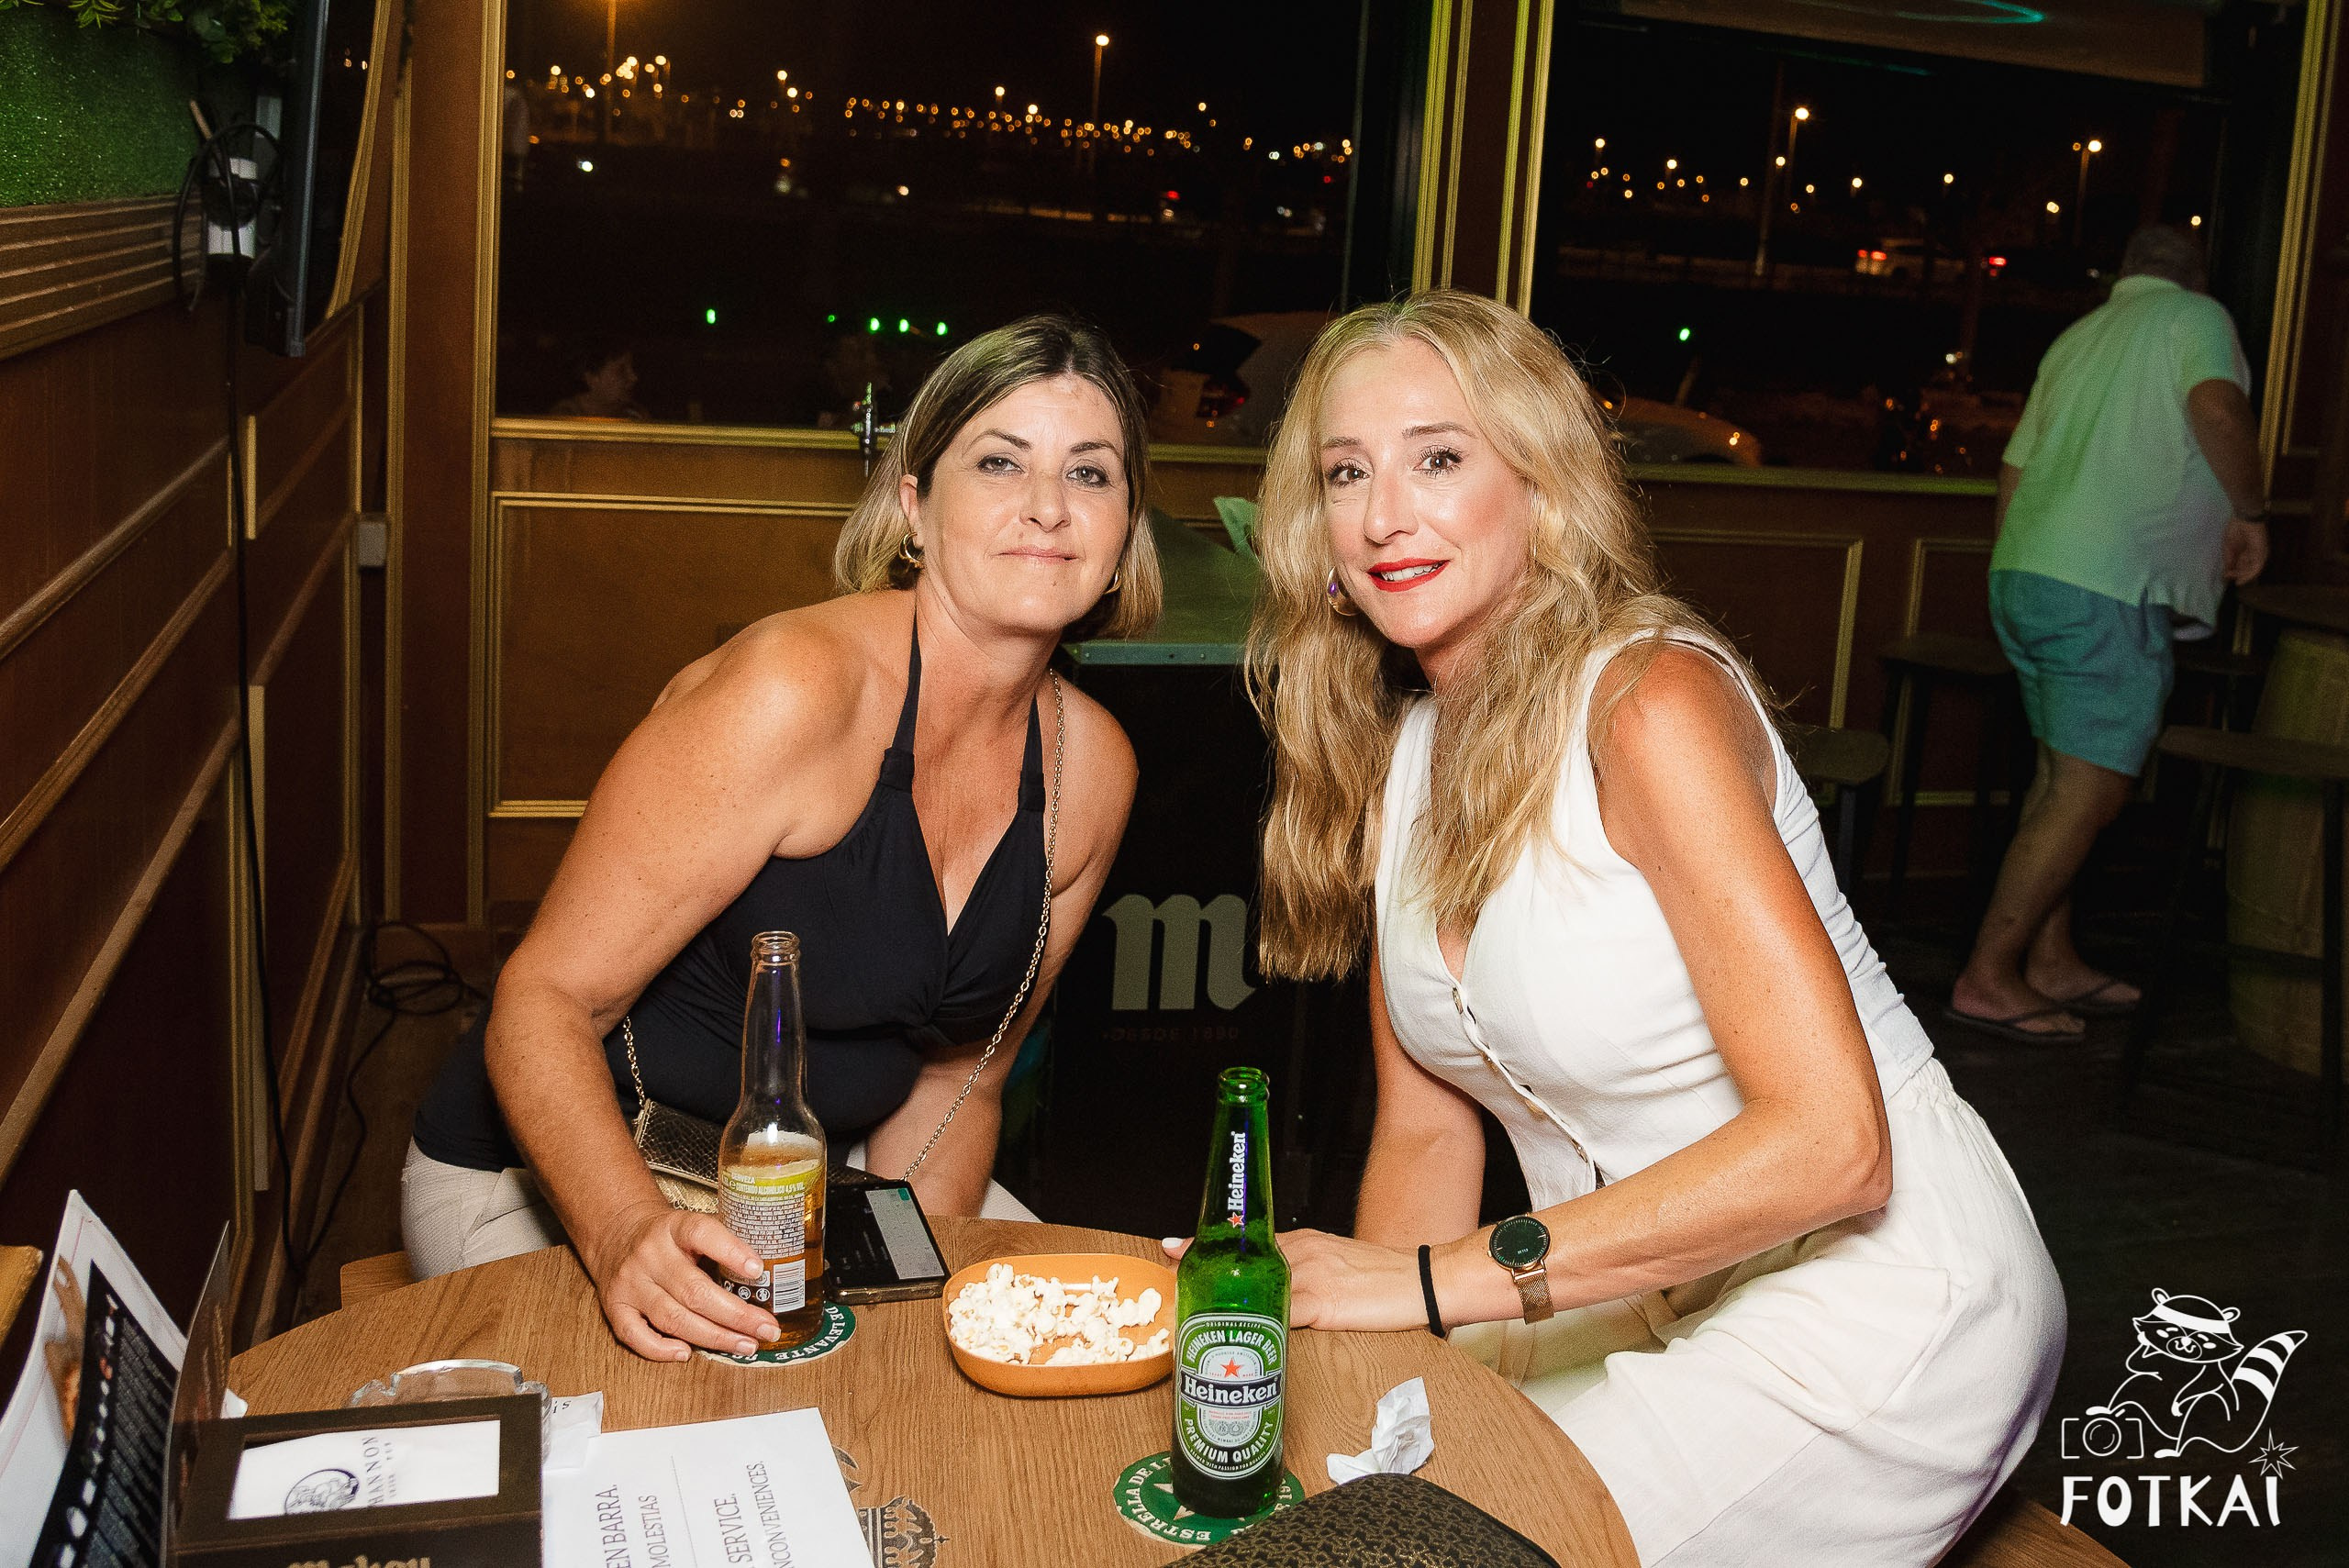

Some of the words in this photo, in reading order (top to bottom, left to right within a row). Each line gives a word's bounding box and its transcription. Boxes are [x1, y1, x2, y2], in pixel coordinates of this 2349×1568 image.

[1228, 1131, 1246, 1211] Heineken
[825, 1306, 845, 1321] DE
[775, 1321, 847, 1361] LEVANTE
[1186, 1329, 1226, 1363] HEINEKEN
[1229, 1330, 1265, 1347] LAGER
[1262, 1340, 1278, 1365] BEER
[1184, 1374, 1277, 1405] Heineken
[1184, 1418, 1229, 1463] PREMIUM
[1232, 1421, 1274, 1462] QUALITY
[1129, 1467, 1153, 1485] DE
[595, 1484, 627, 1545] BARRA.
[714, 1493, 753, 1564] SERVICE.
[1126, 1487, 1211, 1541] ESTRELLA
